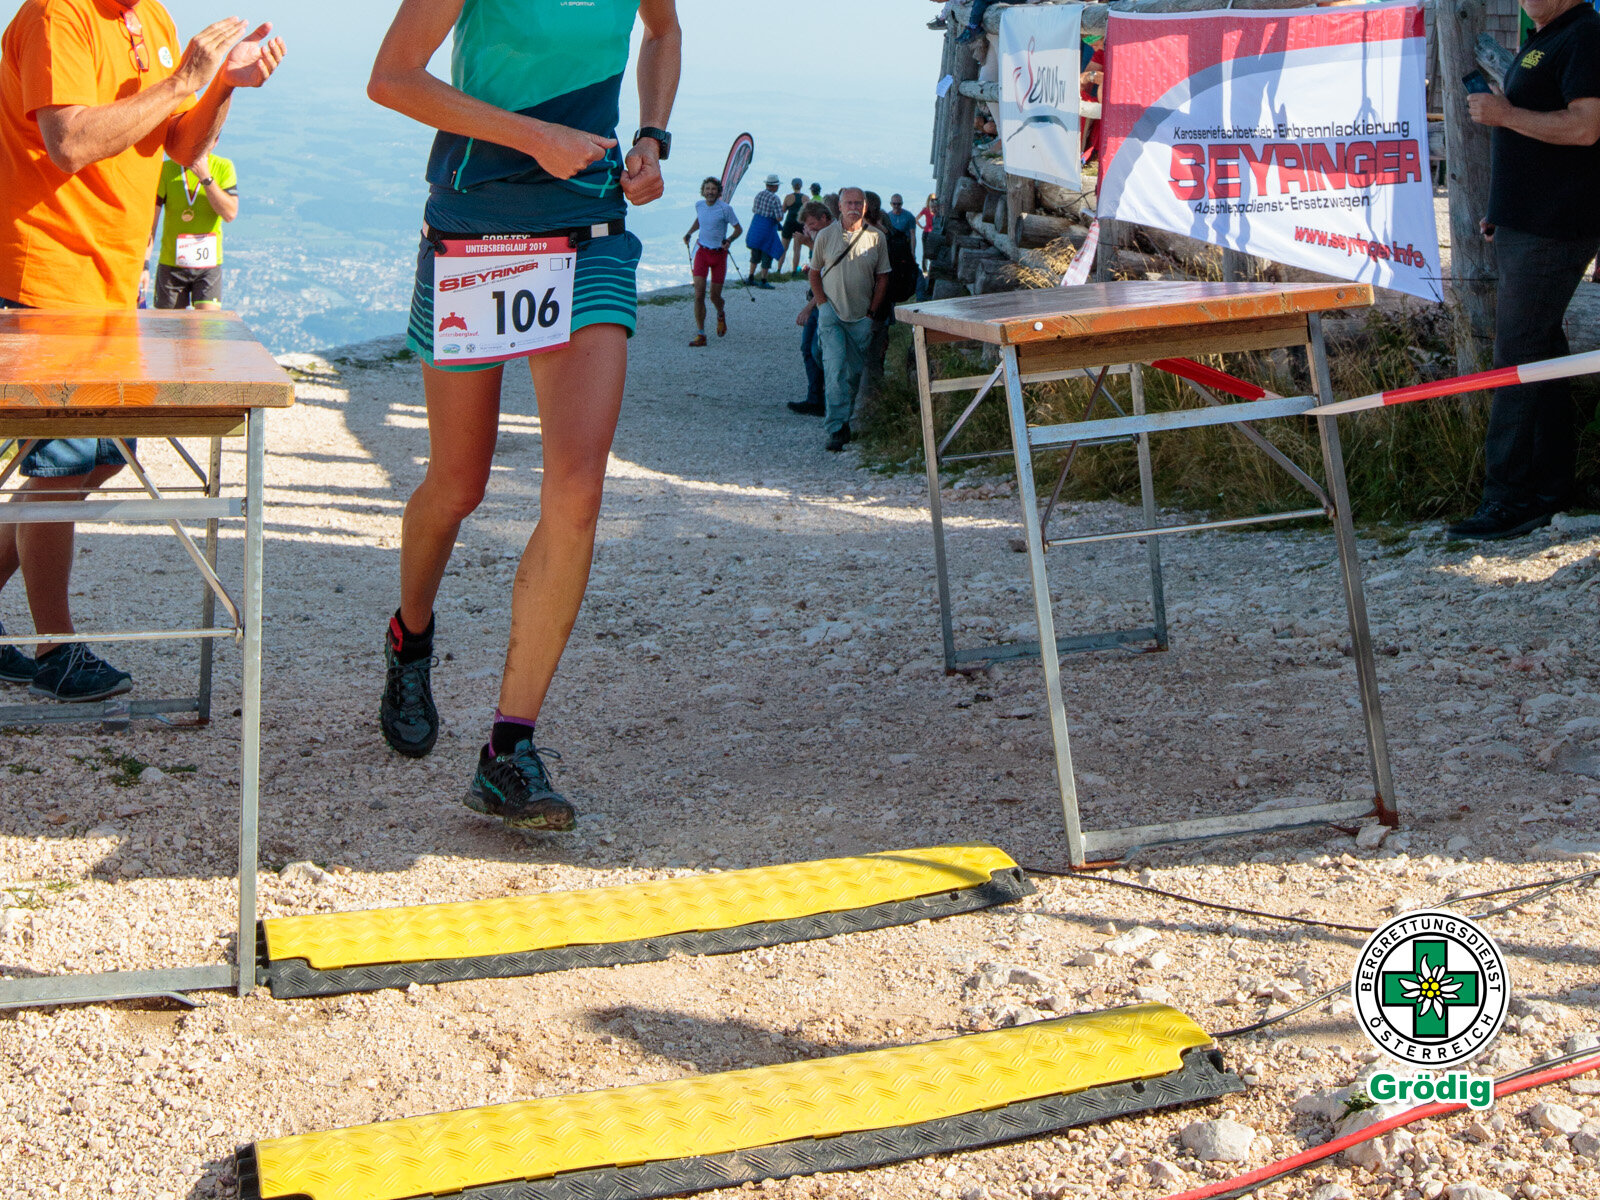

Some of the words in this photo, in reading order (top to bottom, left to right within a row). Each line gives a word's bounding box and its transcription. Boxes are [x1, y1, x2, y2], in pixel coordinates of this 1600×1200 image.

[1168, 139, 1422, 201] SEYRINGER
[196, 247, 209, 261] 50
[465, 243, 528, 254] UNTERSBERGLAUF
[529, 242, 548, 251] 2019
[1294, 226, 1425, 269] www.seyringer.info
[439, 262, 538, 292] SEYRINGER
[565, 257, 572, 269] T
[492, 286, 560, 335] 106
